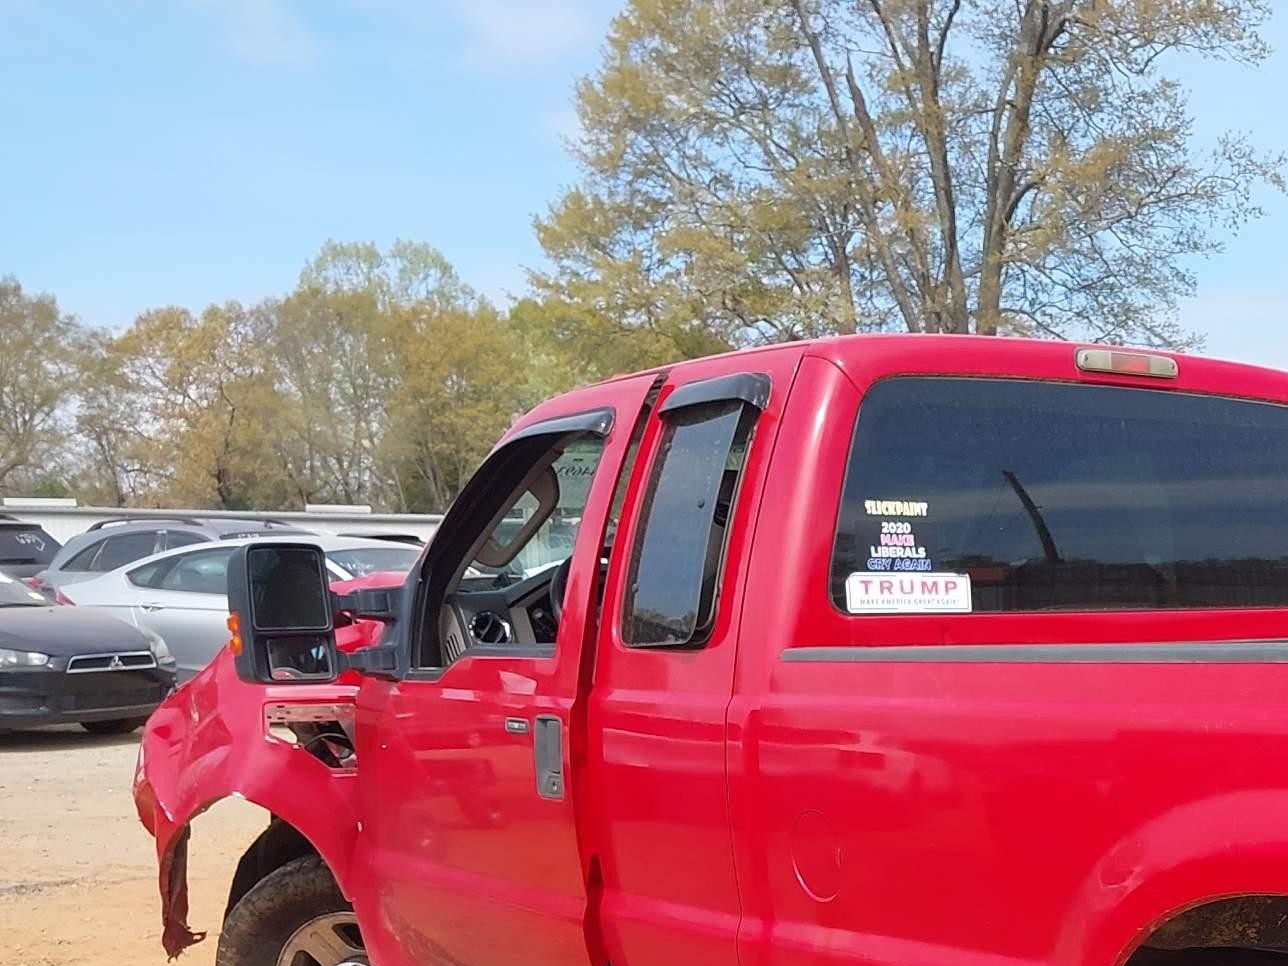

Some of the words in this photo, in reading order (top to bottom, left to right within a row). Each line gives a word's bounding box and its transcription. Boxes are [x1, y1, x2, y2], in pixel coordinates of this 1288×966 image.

[881, 522, 911, 534] 2020
[880, 534, 914, 546] MAKE
[870, 546, 926, 558] LIBERALS
[867, 558, 892, 570] CRY
[894, 559, 931, 571] AGAIN
[860, 580, 957, 595] TRUMP
[914, 598, 934, 606] GREAT
